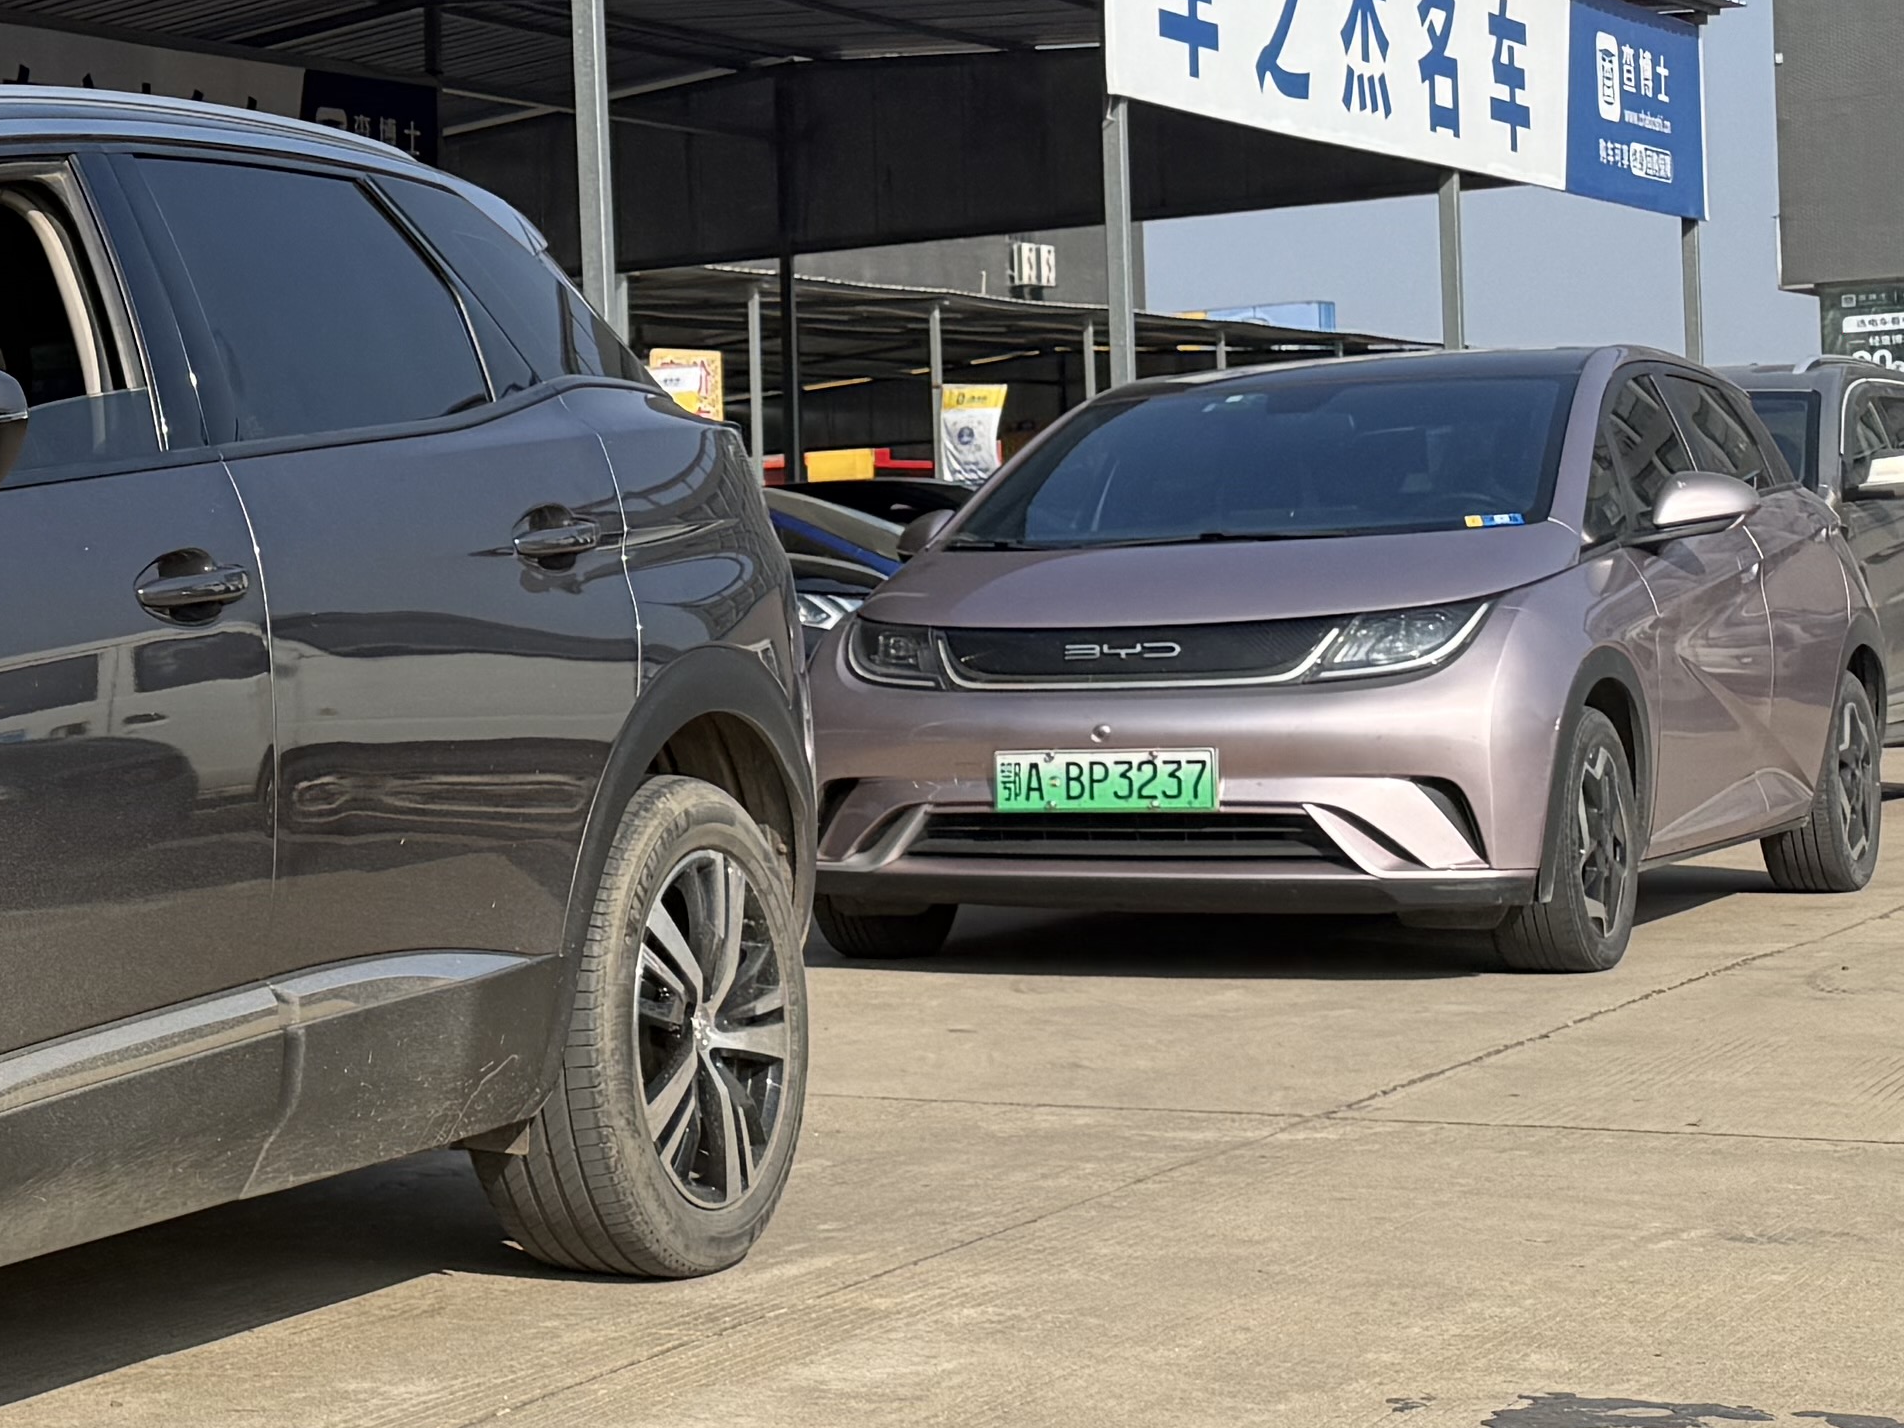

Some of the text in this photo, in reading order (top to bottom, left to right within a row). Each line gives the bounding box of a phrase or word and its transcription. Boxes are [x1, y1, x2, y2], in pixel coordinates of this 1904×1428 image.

[1621, 43, 1670, 103] 查博士
[1063, 641, 1182, 660] BYD
